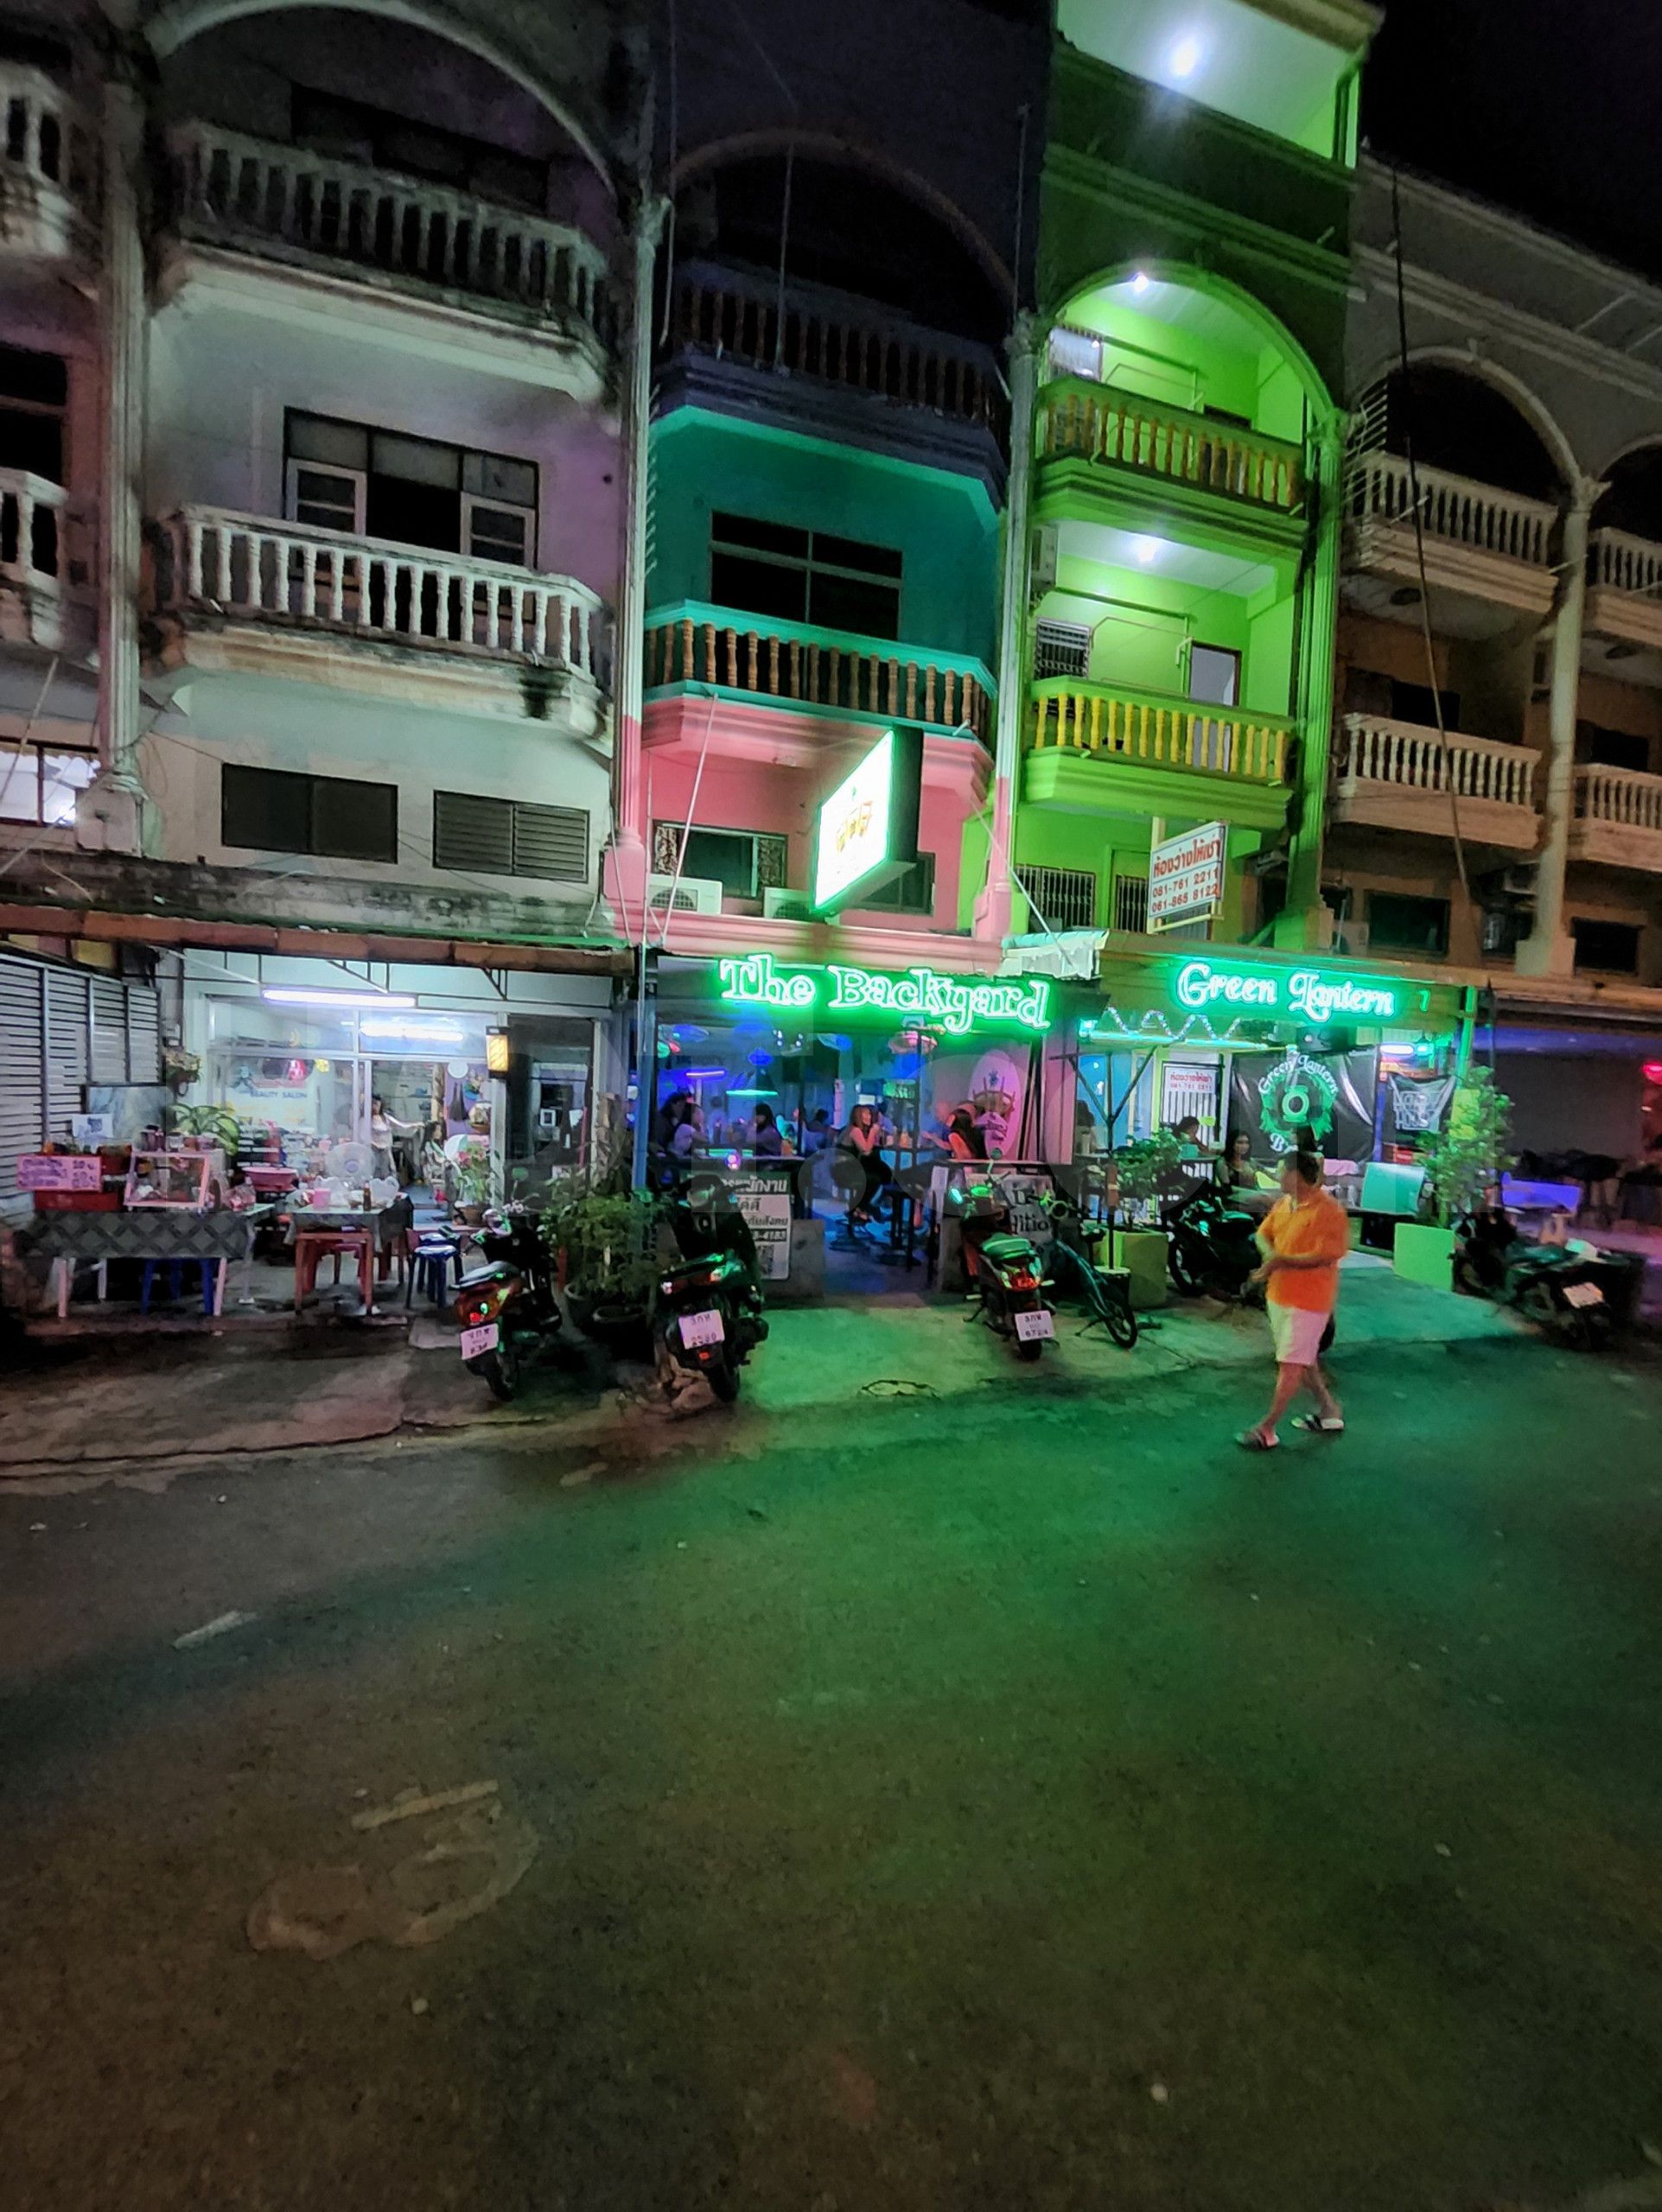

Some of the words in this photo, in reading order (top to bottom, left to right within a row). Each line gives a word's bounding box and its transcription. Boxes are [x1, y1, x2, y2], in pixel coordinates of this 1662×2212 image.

[1153, 877, 1189, 898] 081-761
[719, 954, 816, 1005] The
[827, 966, 1049, 1034] Backyard
[1175, 961, 1277, 1007] Green
[1287, 969, 1395, 1023] Lantern
